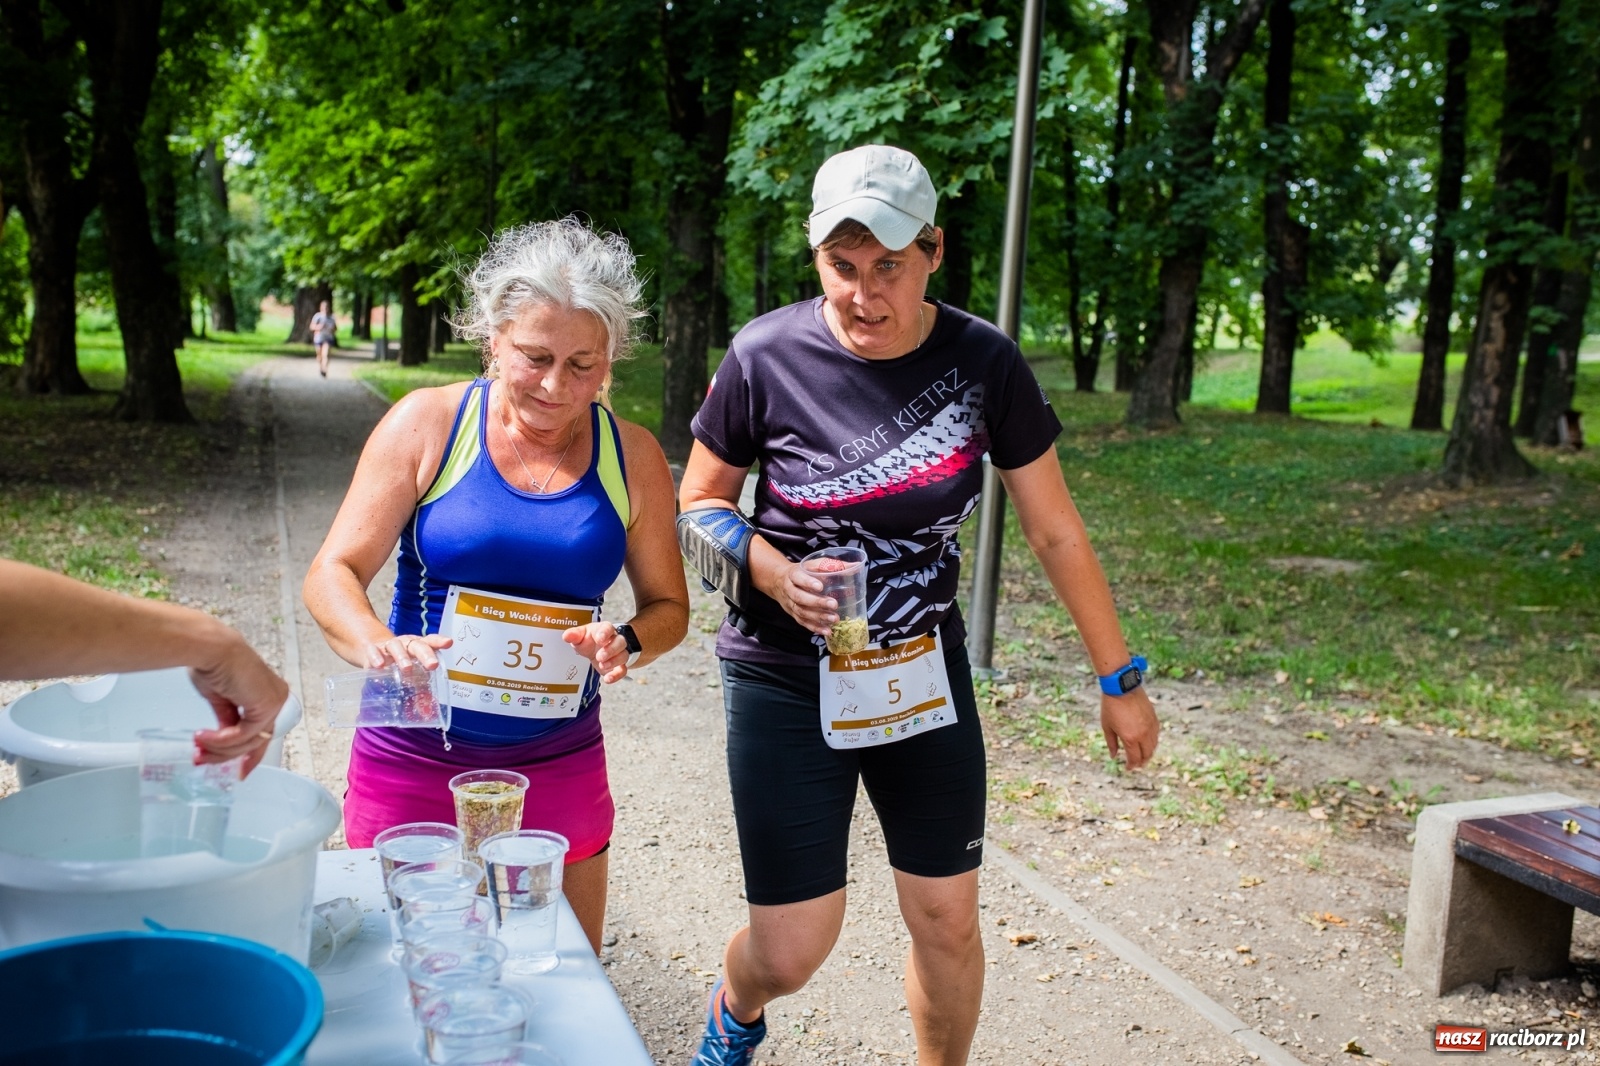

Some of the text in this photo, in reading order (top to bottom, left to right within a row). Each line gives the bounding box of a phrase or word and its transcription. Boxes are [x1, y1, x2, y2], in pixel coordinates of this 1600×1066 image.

[805, 367, 968, 477] KS GRYF KIETRZ
[482, 606, 505, 619] Bieg
[509, 610, 542, 623] Wokół
[544, 615, 578, 627] Komina
[503, 640, 544, 671] 35
[851, 659, 869, 668] Bieg
[870, 653, 899, 665] Wokół
[901, 645, 925, 659] Komina
[486, 679, 522, 689] 03.08.2019
[888, 678, 902, 705] 5
